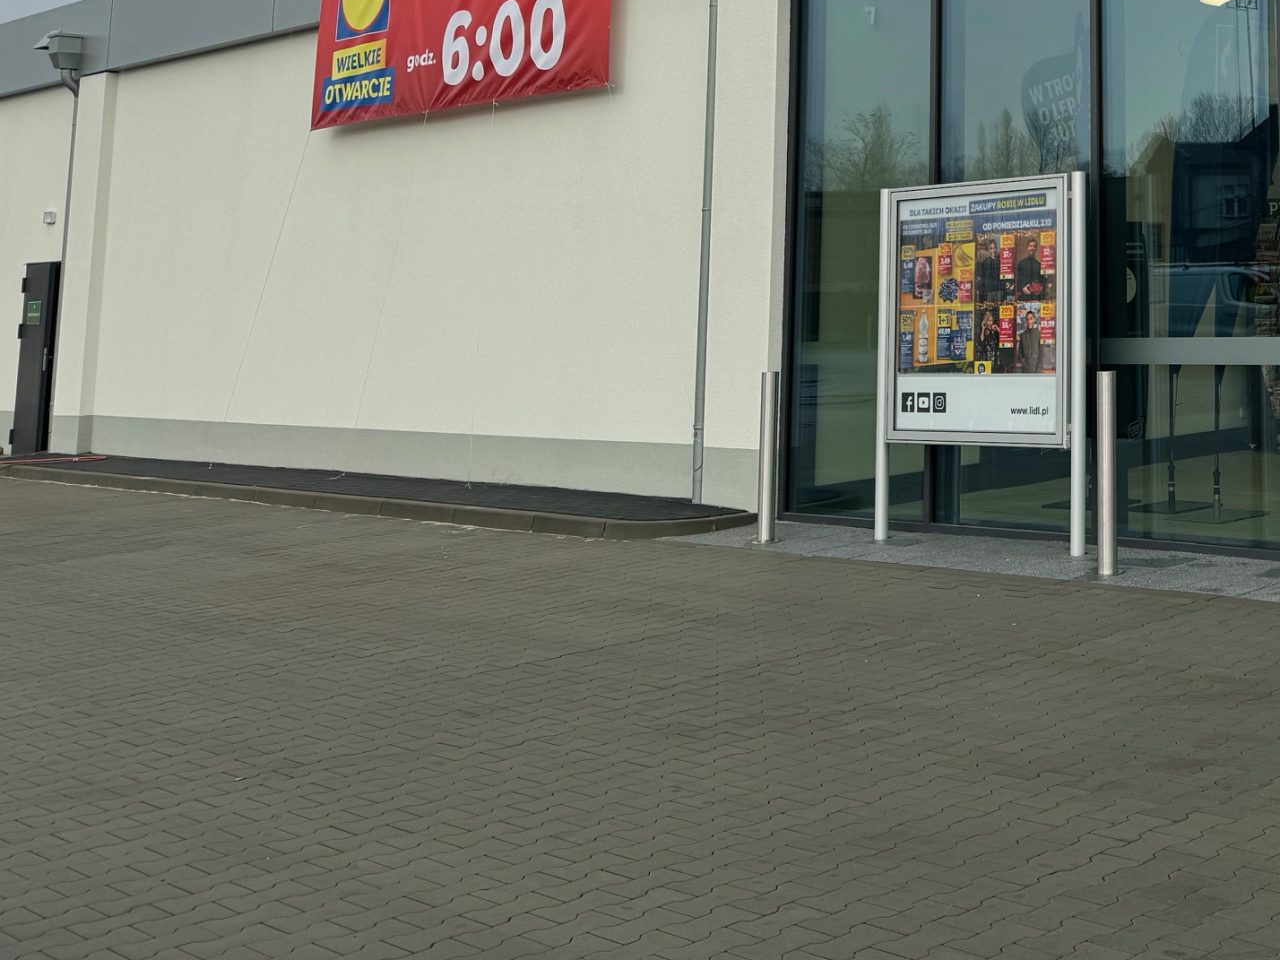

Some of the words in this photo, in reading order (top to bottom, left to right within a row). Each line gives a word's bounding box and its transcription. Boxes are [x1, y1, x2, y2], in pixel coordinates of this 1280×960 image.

[336, 47, 382, 71] WIELKIE
[406, 49, 437, 73] godz.
[324, 76, 391, 105] OTWARCIE
[1010, 406, 1049, 417] www.lidl.pl
